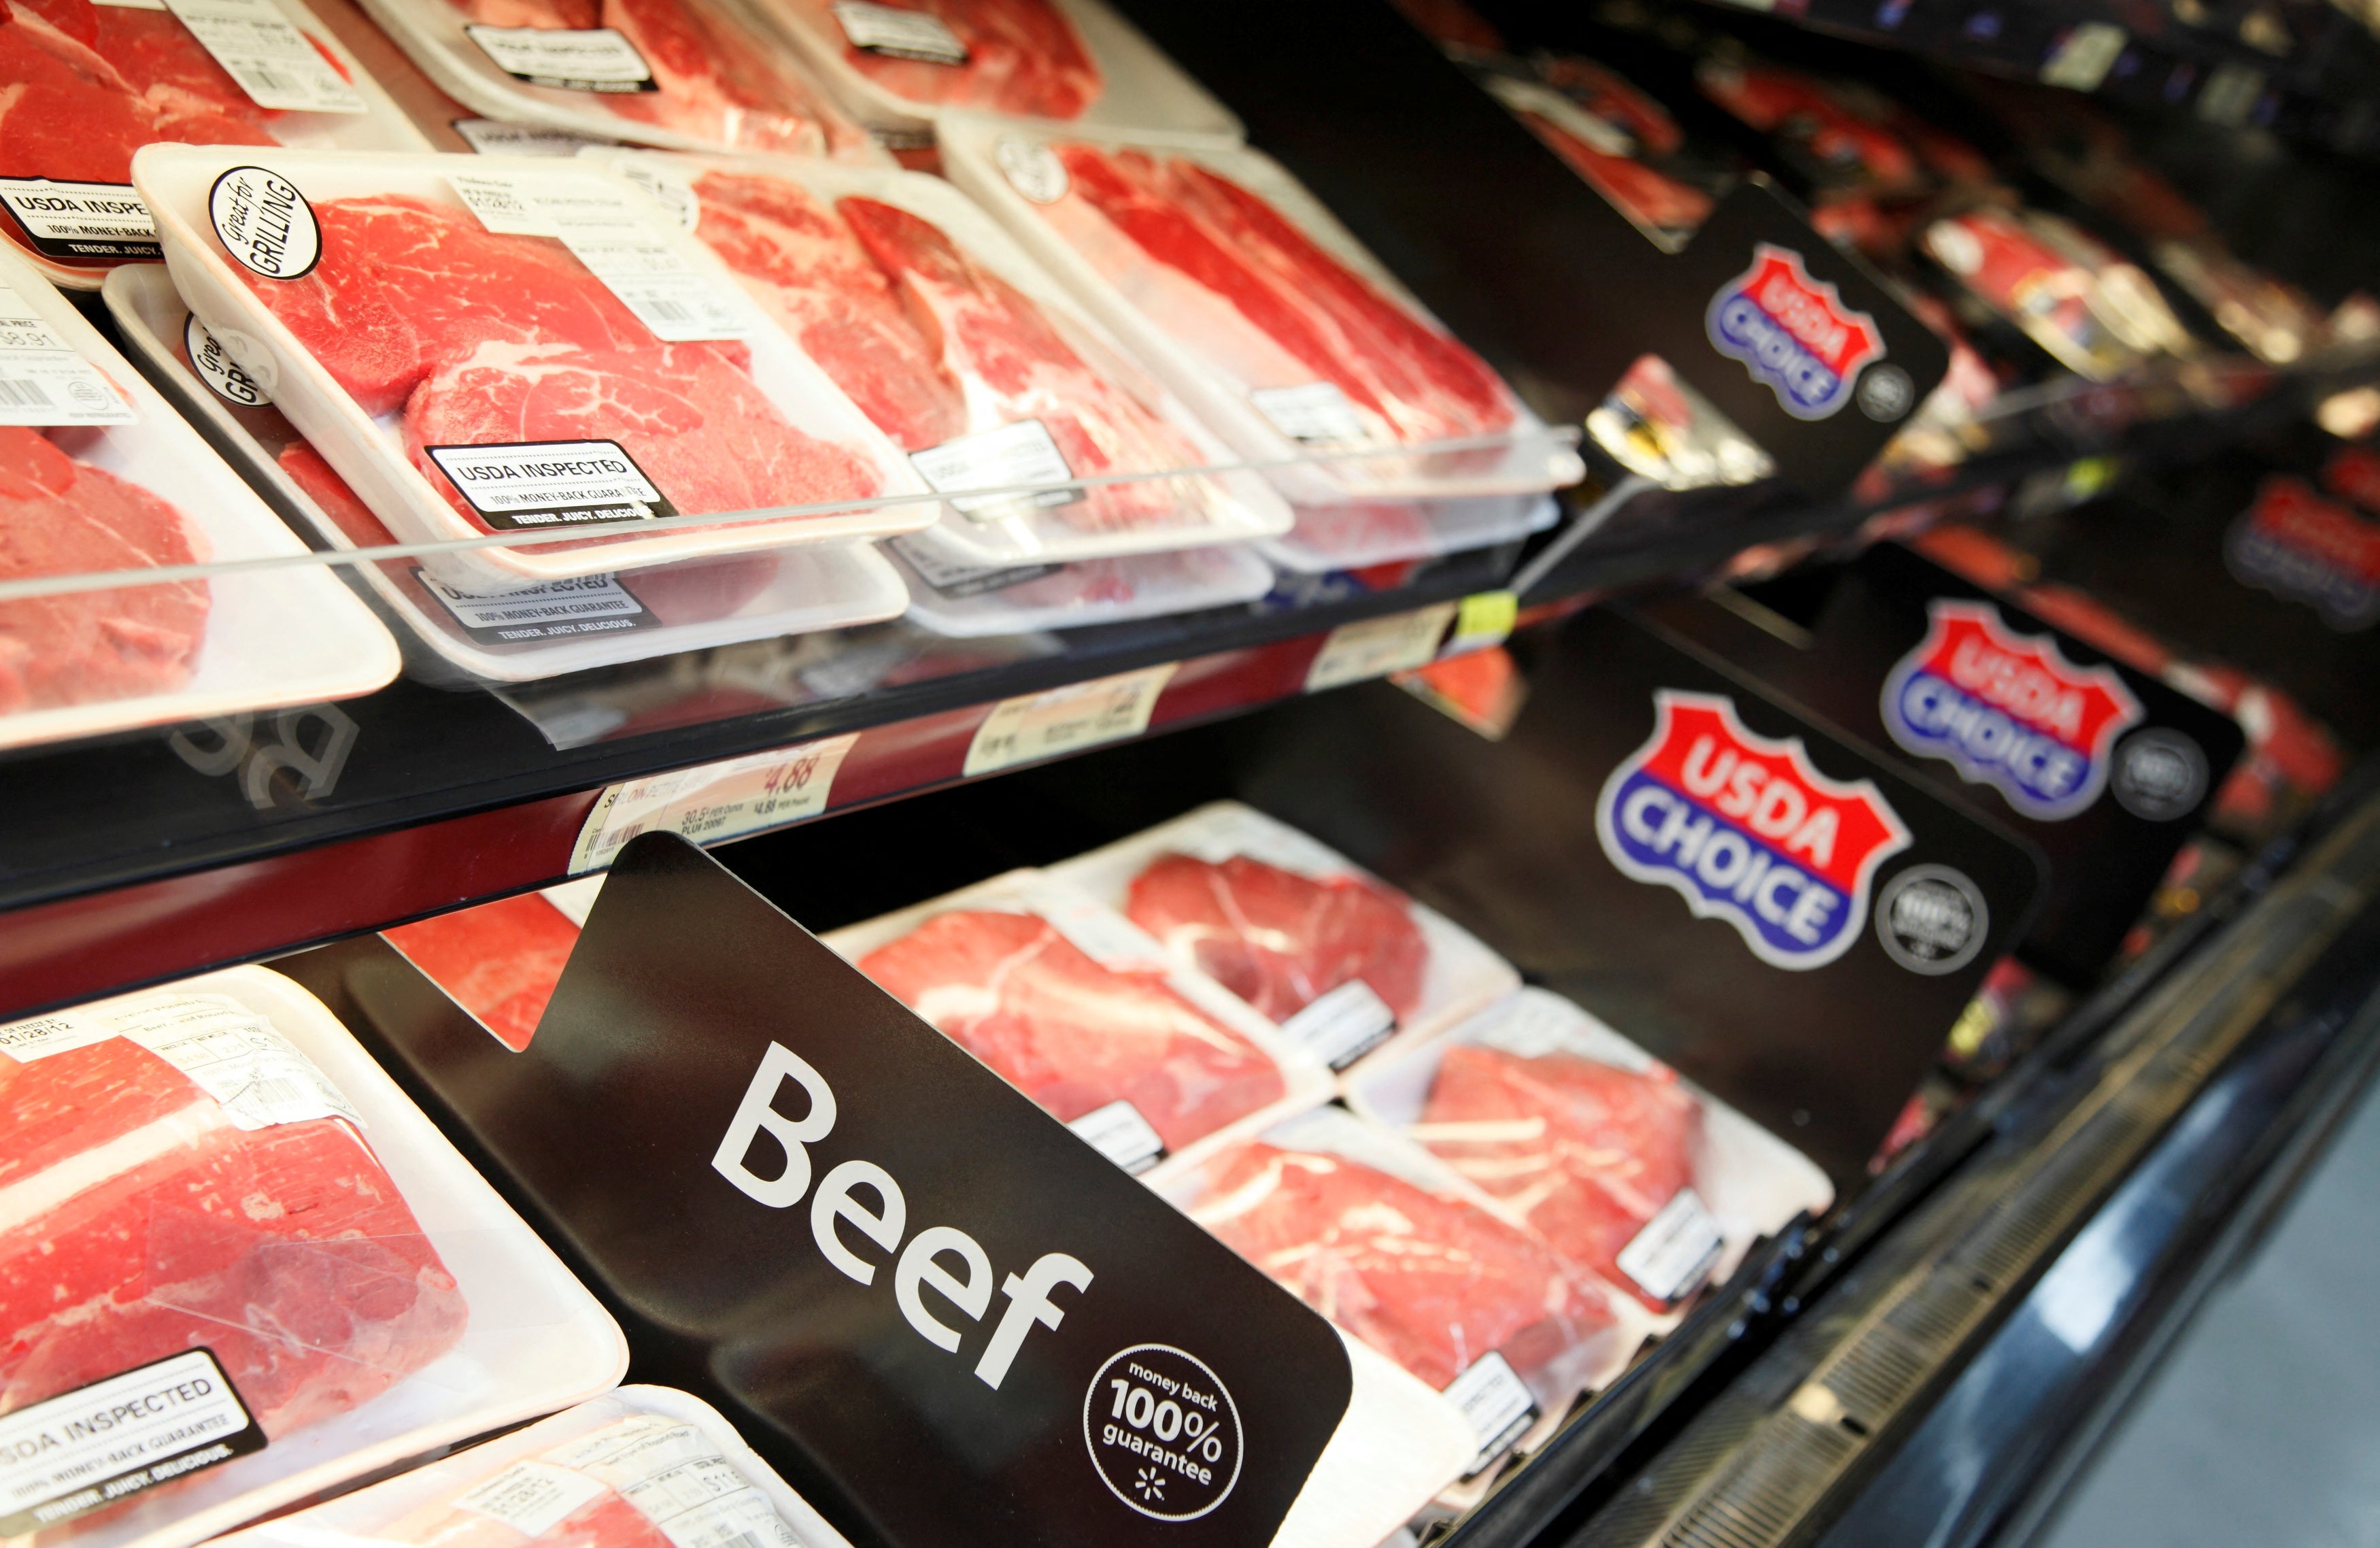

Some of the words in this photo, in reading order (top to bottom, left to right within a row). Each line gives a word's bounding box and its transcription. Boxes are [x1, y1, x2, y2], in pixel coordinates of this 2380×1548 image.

[14, 196, 83, 214] USDA
[83, 199, 150, 216] INSPE
[47, 224, 80, 235] 100%
[79, 225, 152, 238] MONEY-BACK
[250, 180, 296, 275] GRILLING
[69, 243, 120, 254] TENDER.
[124, 246, 160, 256] JUICY.
[1760, 272, 1849, 363] USDA
[458, 465, 519, 481] USDA
[522, 459, 628, 478] INSPECTED
[490, 495, 520, 505] 100%
[520, 490, 587, 504] MONEY-BACK
[588, 486, 647, 499] GUARATEE
[512, 514, 562, 525] TENDER.
[562, 511, 595, 522] JUICY.
[597, 507, 655, 520] DELICIO.
[475, 611, 503, 622] 100%
[504, 605, 570, 620] MONEY-BACK
[571, 600, 630, 613] GUARANTEE
[498, 628, 545, 640] TENDER.
[545, 624, 580, 635] JUICY.
[579, 619, 636, 632] DELICIOUS.
[1950, 635, 2085, 741] USDA
[1902, 673, 2079, 799] CHOICE
[1680, 733, 1841, 870] USDA
[1620, 784, 1840, 946] CHOICE
[0, 1022, 74, 1045] 01/28/12
[711, 1039, 1094, 1391] Beef
[1129, 1362, 1180, 1396] money
[1182, 1382, 1219, 1412] back
[0, 1433, 62, 1463] SDA
[63, 1378, 213, 1442] INSPECTED
[148, 1413, 231, 1449] GUARANTEE
[1111, 1378, 1223, 1462] 100%
[1102, 1424, 1212, 1485] guarantee
